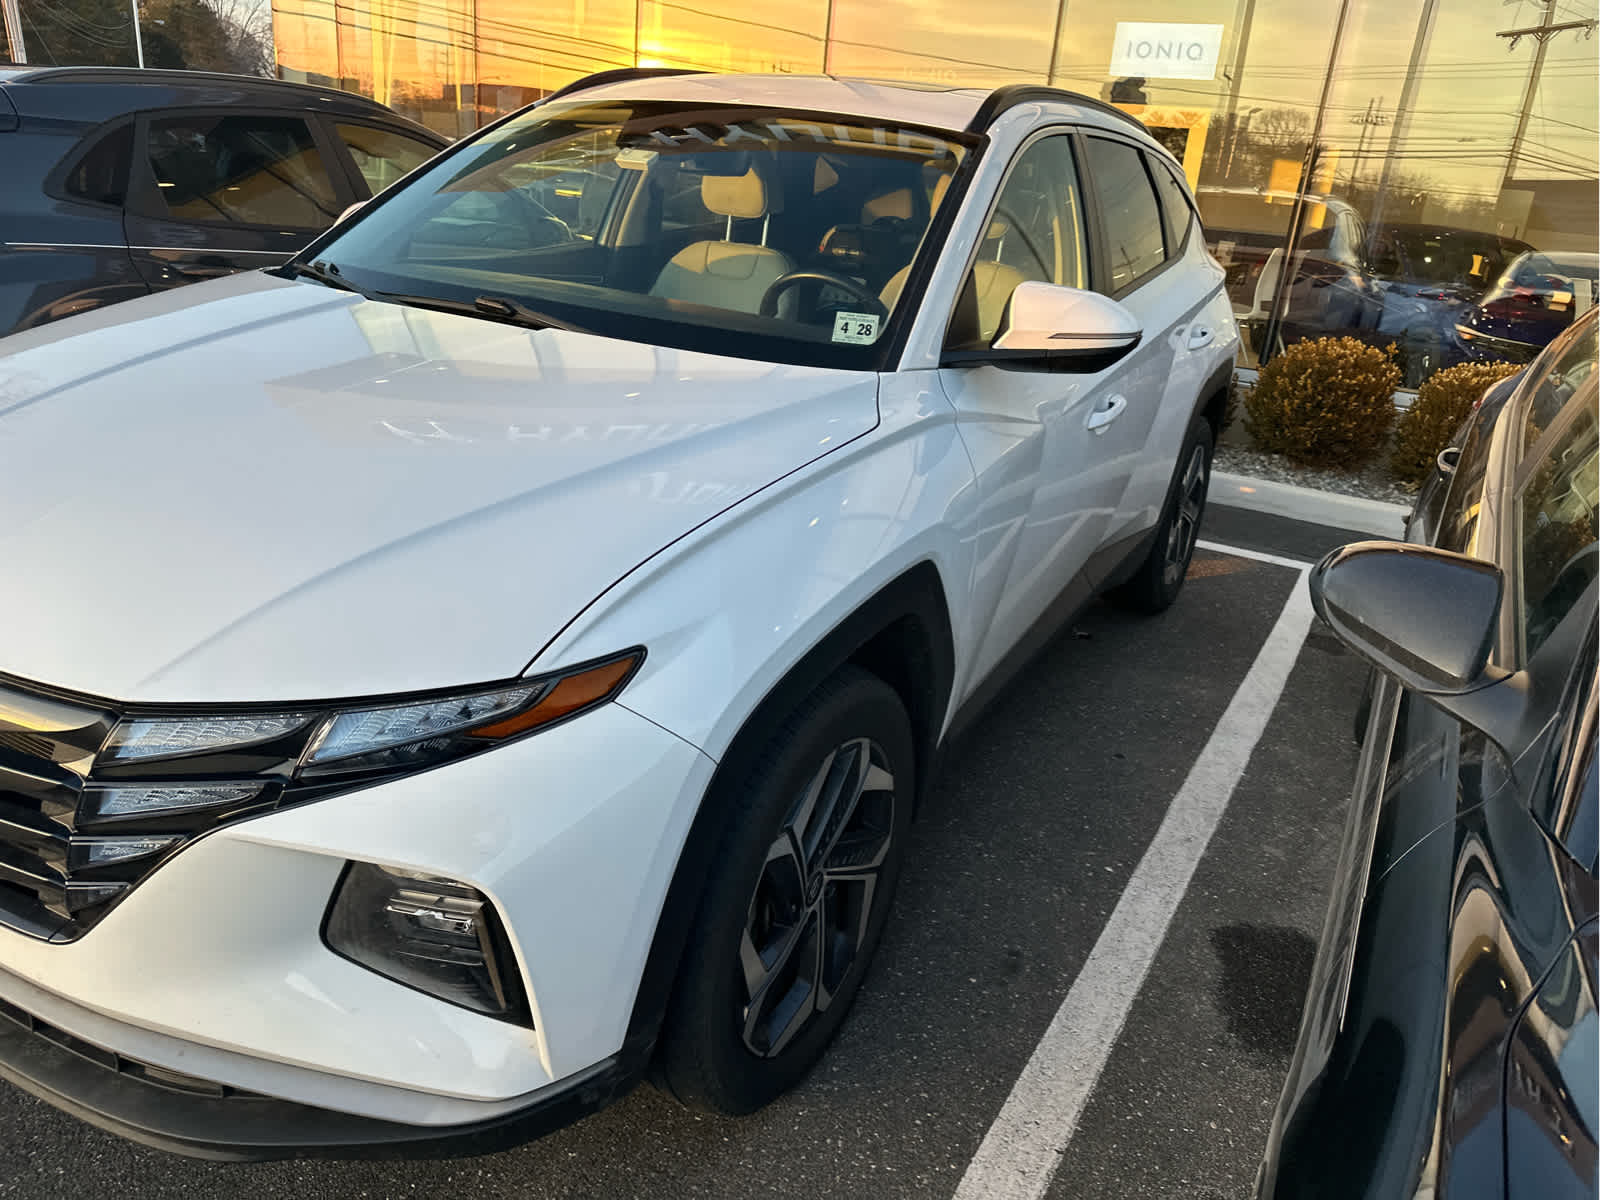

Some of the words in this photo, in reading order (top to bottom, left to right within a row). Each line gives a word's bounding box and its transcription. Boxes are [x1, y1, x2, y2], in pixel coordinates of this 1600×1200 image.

[1127, 40, 1204, 61] IONIQ
[840, 321, 849, 334] 4
[856, 323, 873, 336] 28
